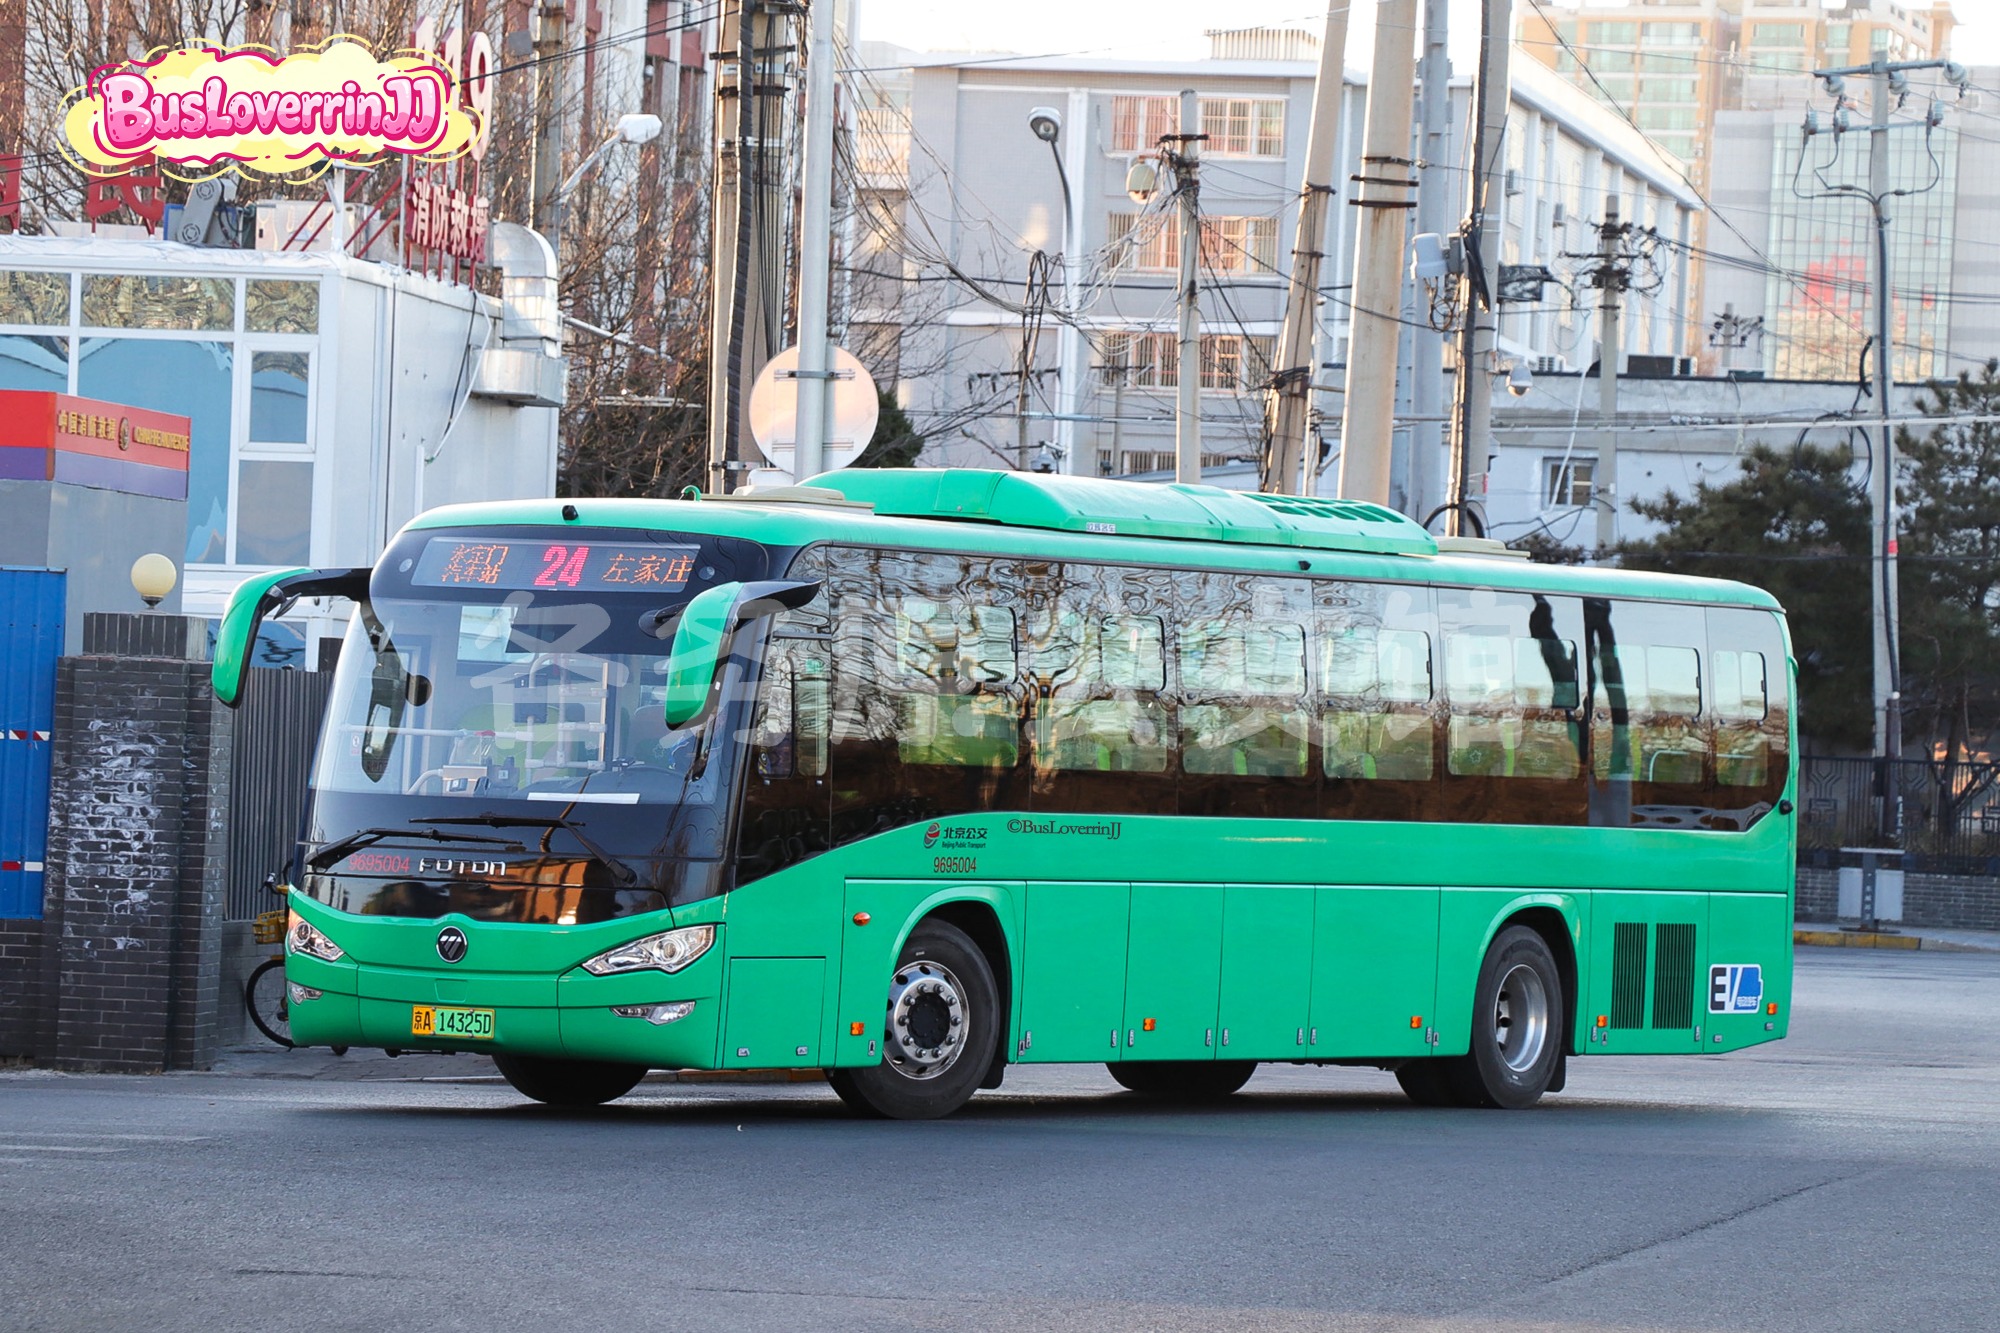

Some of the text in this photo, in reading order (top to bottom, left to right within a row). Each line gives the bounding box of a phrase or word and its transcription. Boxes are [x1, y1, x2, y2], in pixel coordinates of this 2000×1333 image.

[406, 176, 490, 264] 消防救援
[534, 545, 589, 587] 24
[601, 553, 695, 585] 左家庄
[943, 827, 989, 840] 北京公交
[349, 853, 507, 876] 9695004 FOTON
[933, 856, 977, 873] 9695004
